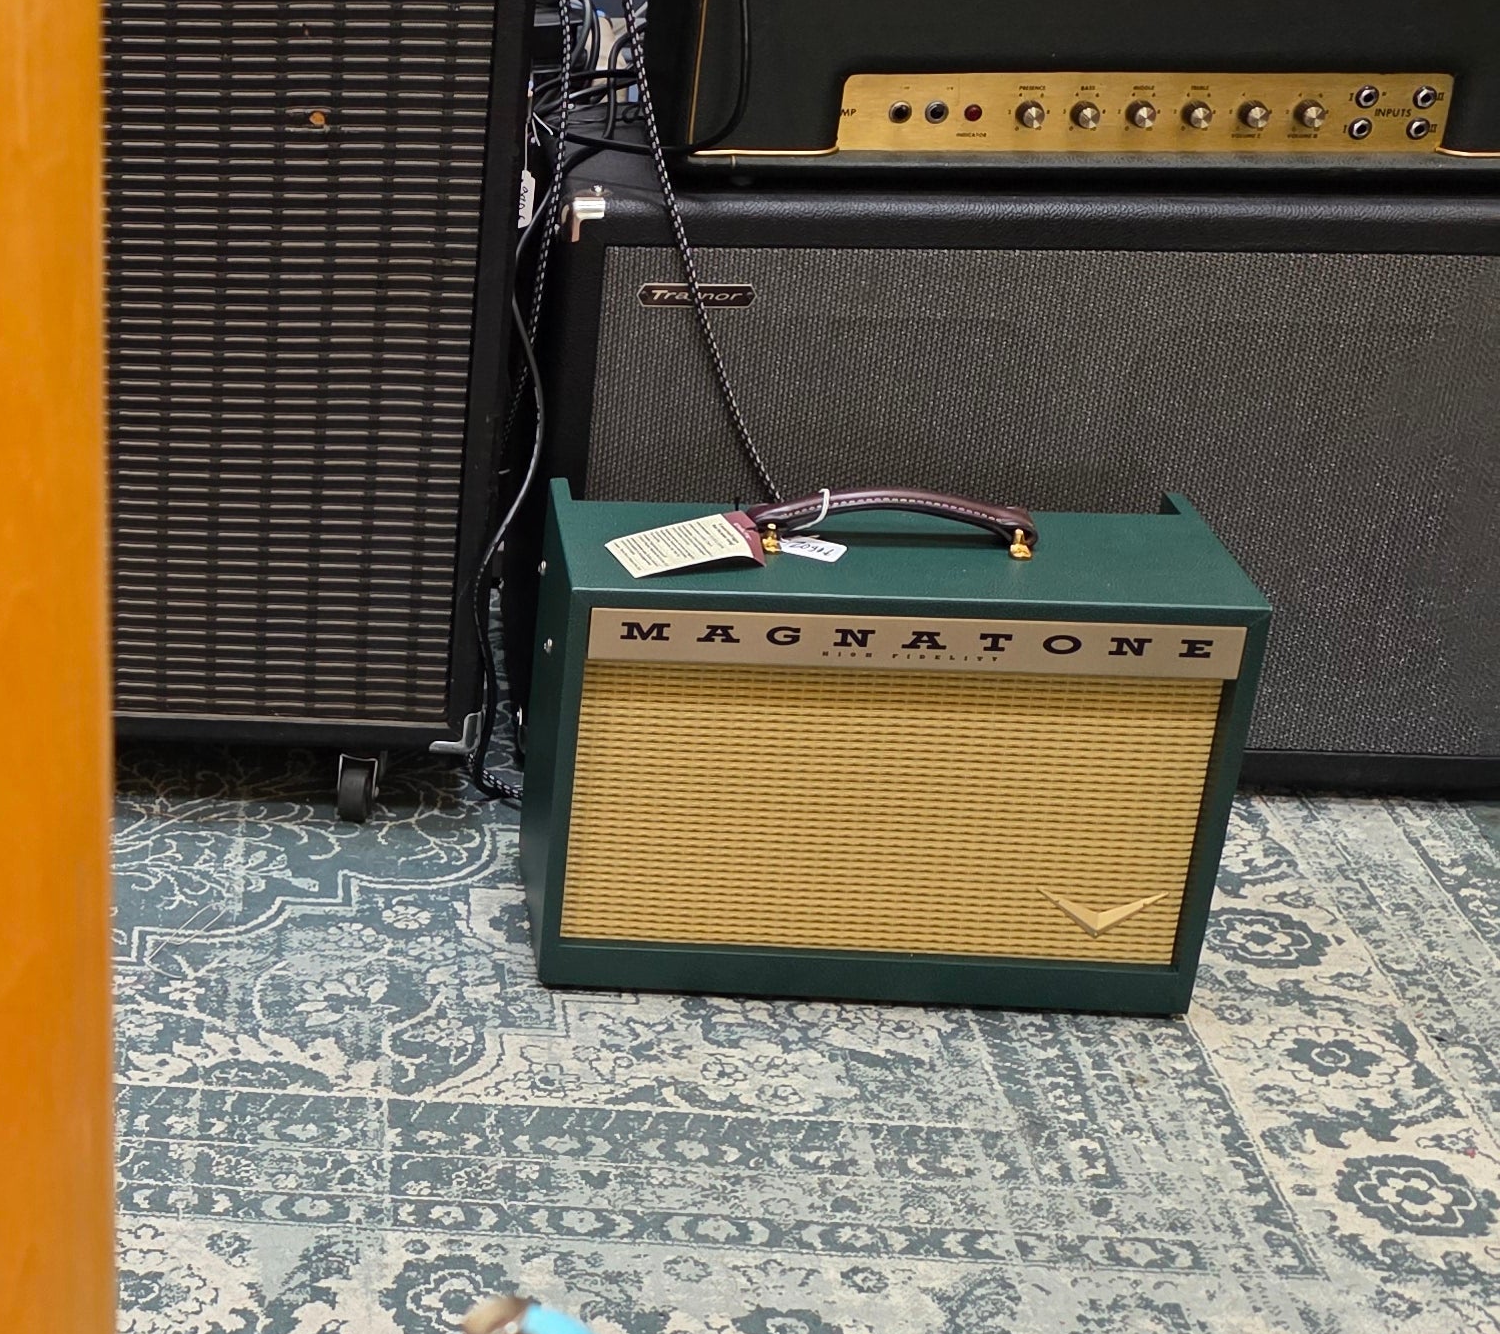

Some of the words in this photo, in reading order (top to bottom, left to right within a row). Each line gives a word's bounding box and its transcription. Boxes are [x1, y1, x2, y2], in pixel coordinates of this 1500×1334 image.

[1374, 108, 1412, 117] INPUTS
[651, 289, 743, 302] Tranor
[619, 621, 1215, 659] MAGNATONE
